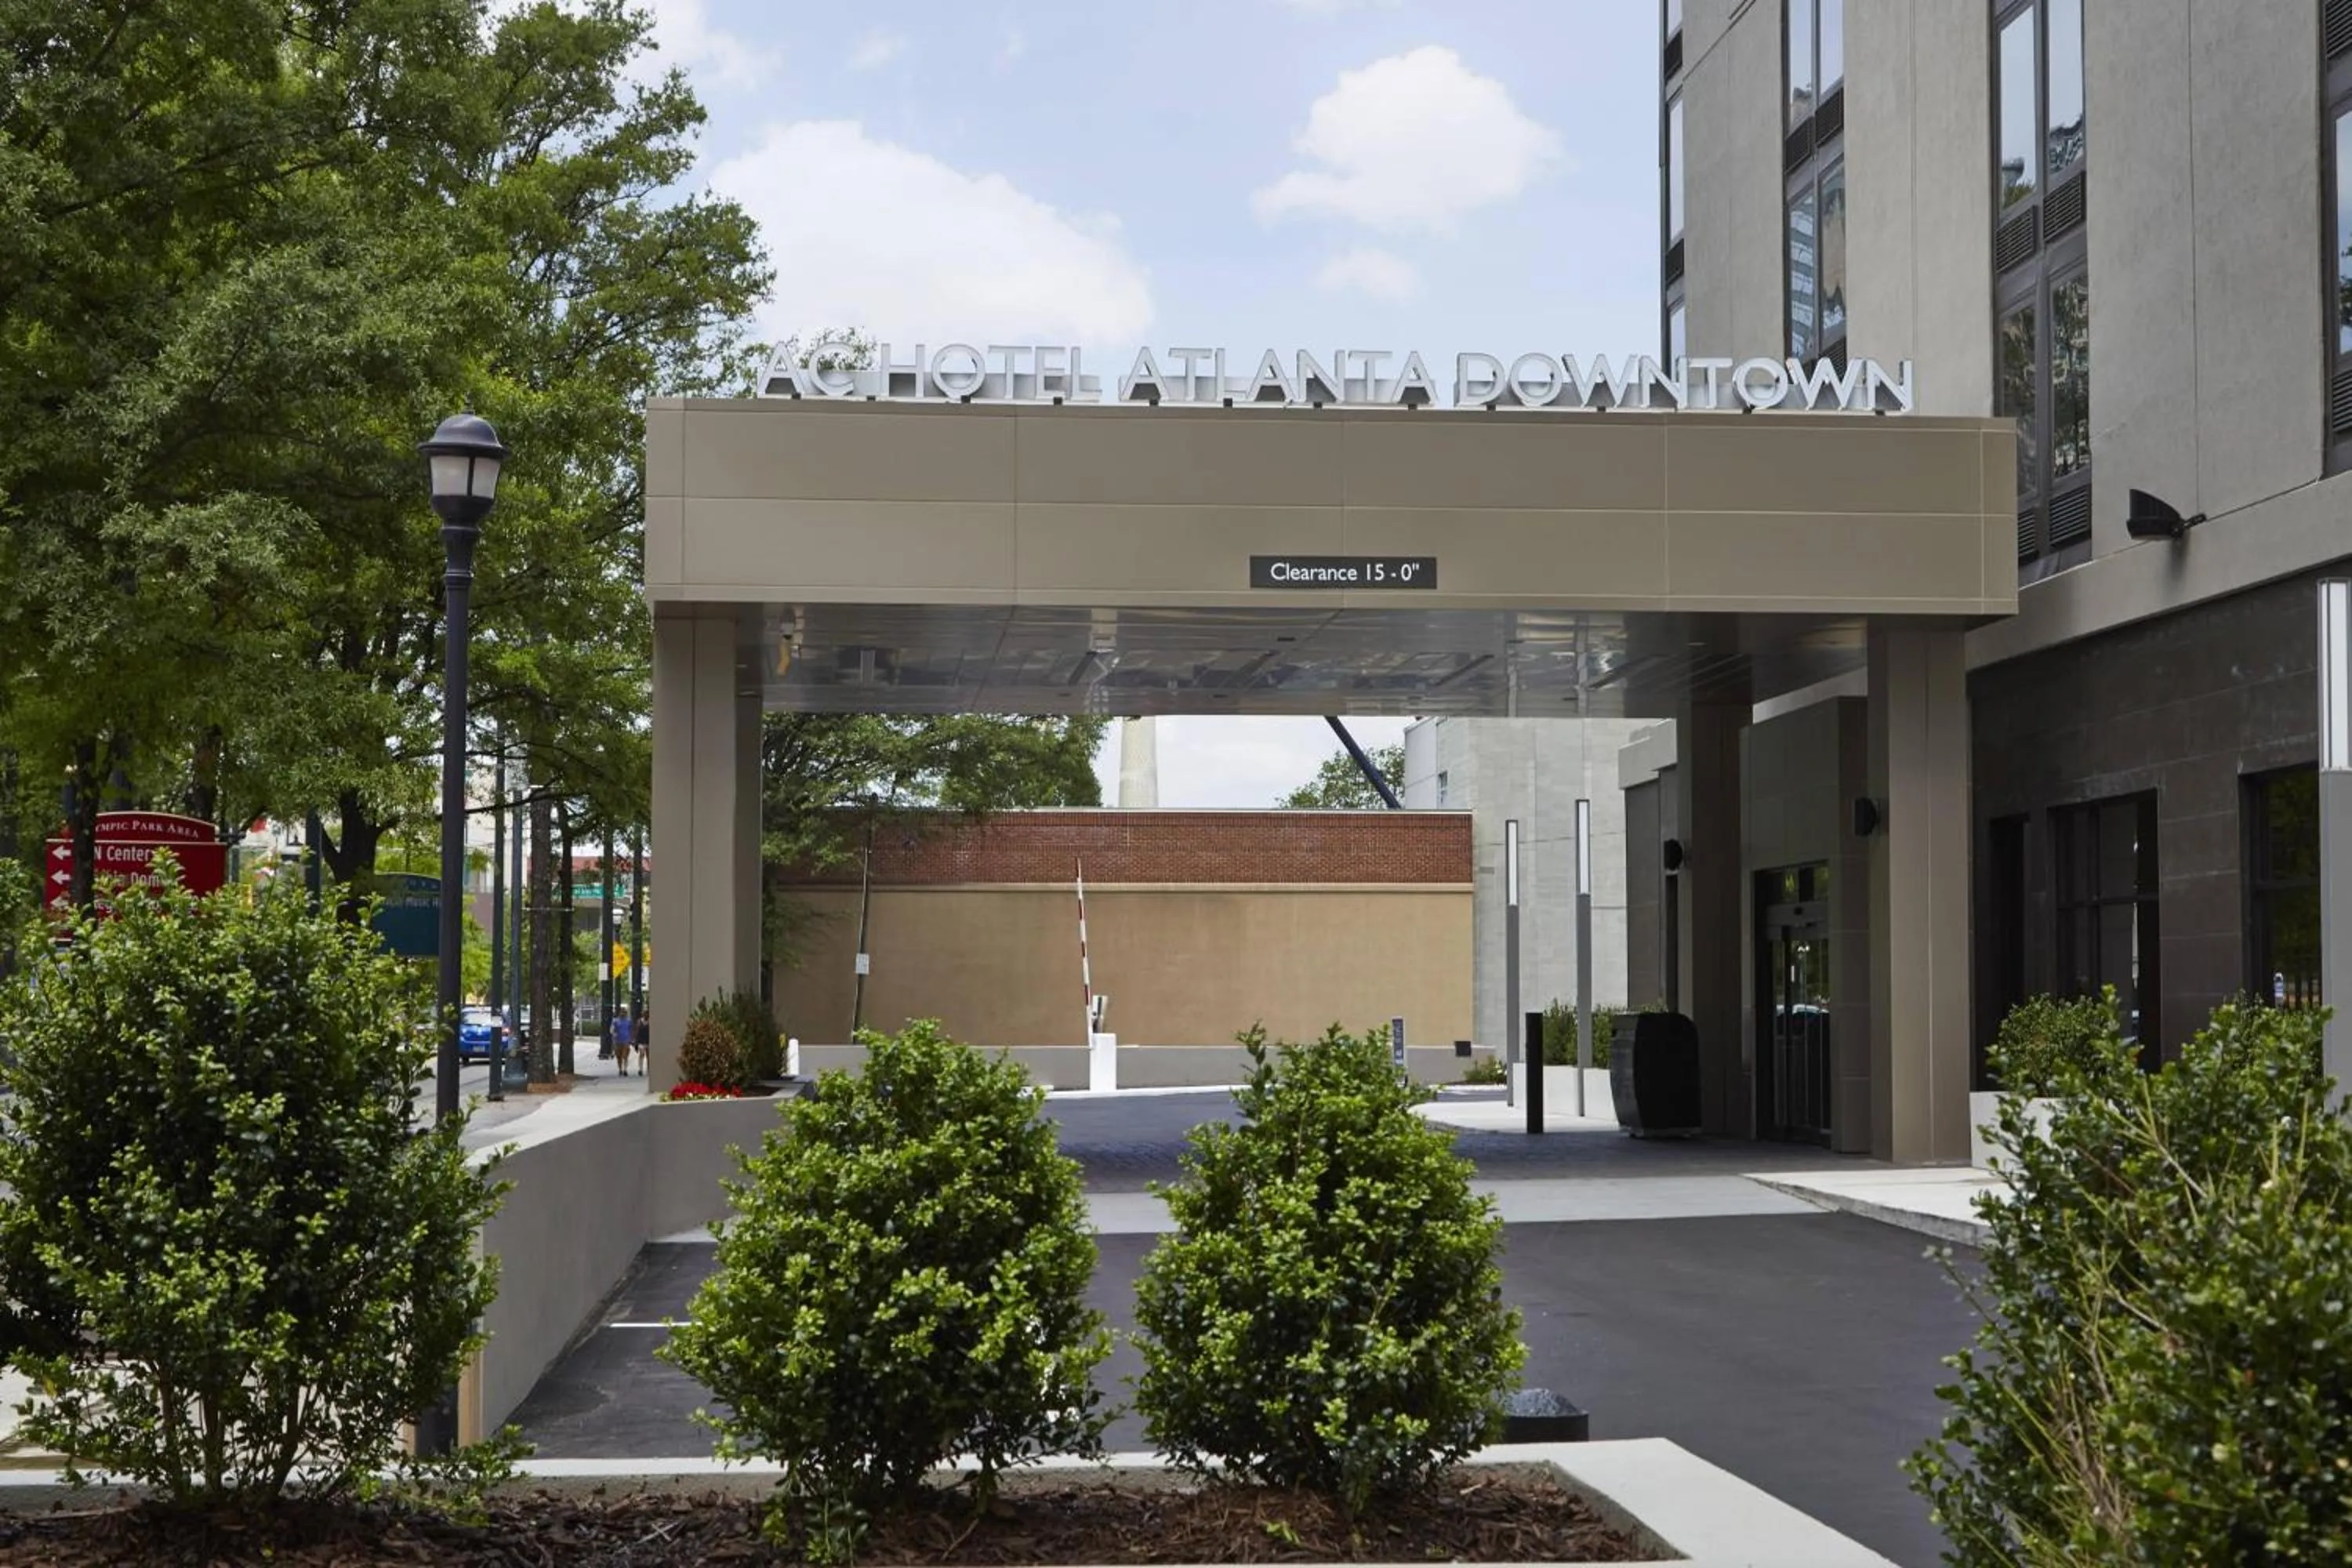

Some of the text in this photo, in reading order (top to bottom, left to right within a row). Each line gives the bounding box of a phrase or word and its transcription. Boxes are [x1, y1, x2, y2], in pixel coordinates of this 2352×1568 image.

[757, 339, 1913, 414] AC HOTEL ATLANTA DOWNTOWN
[1270, 562, 1358, 581] Clearance
[1367, 564, 1385, 581] 15
[95, 820, 199, 838] YMPIC PARK AREA
[107, 845, 151, 862] Center
